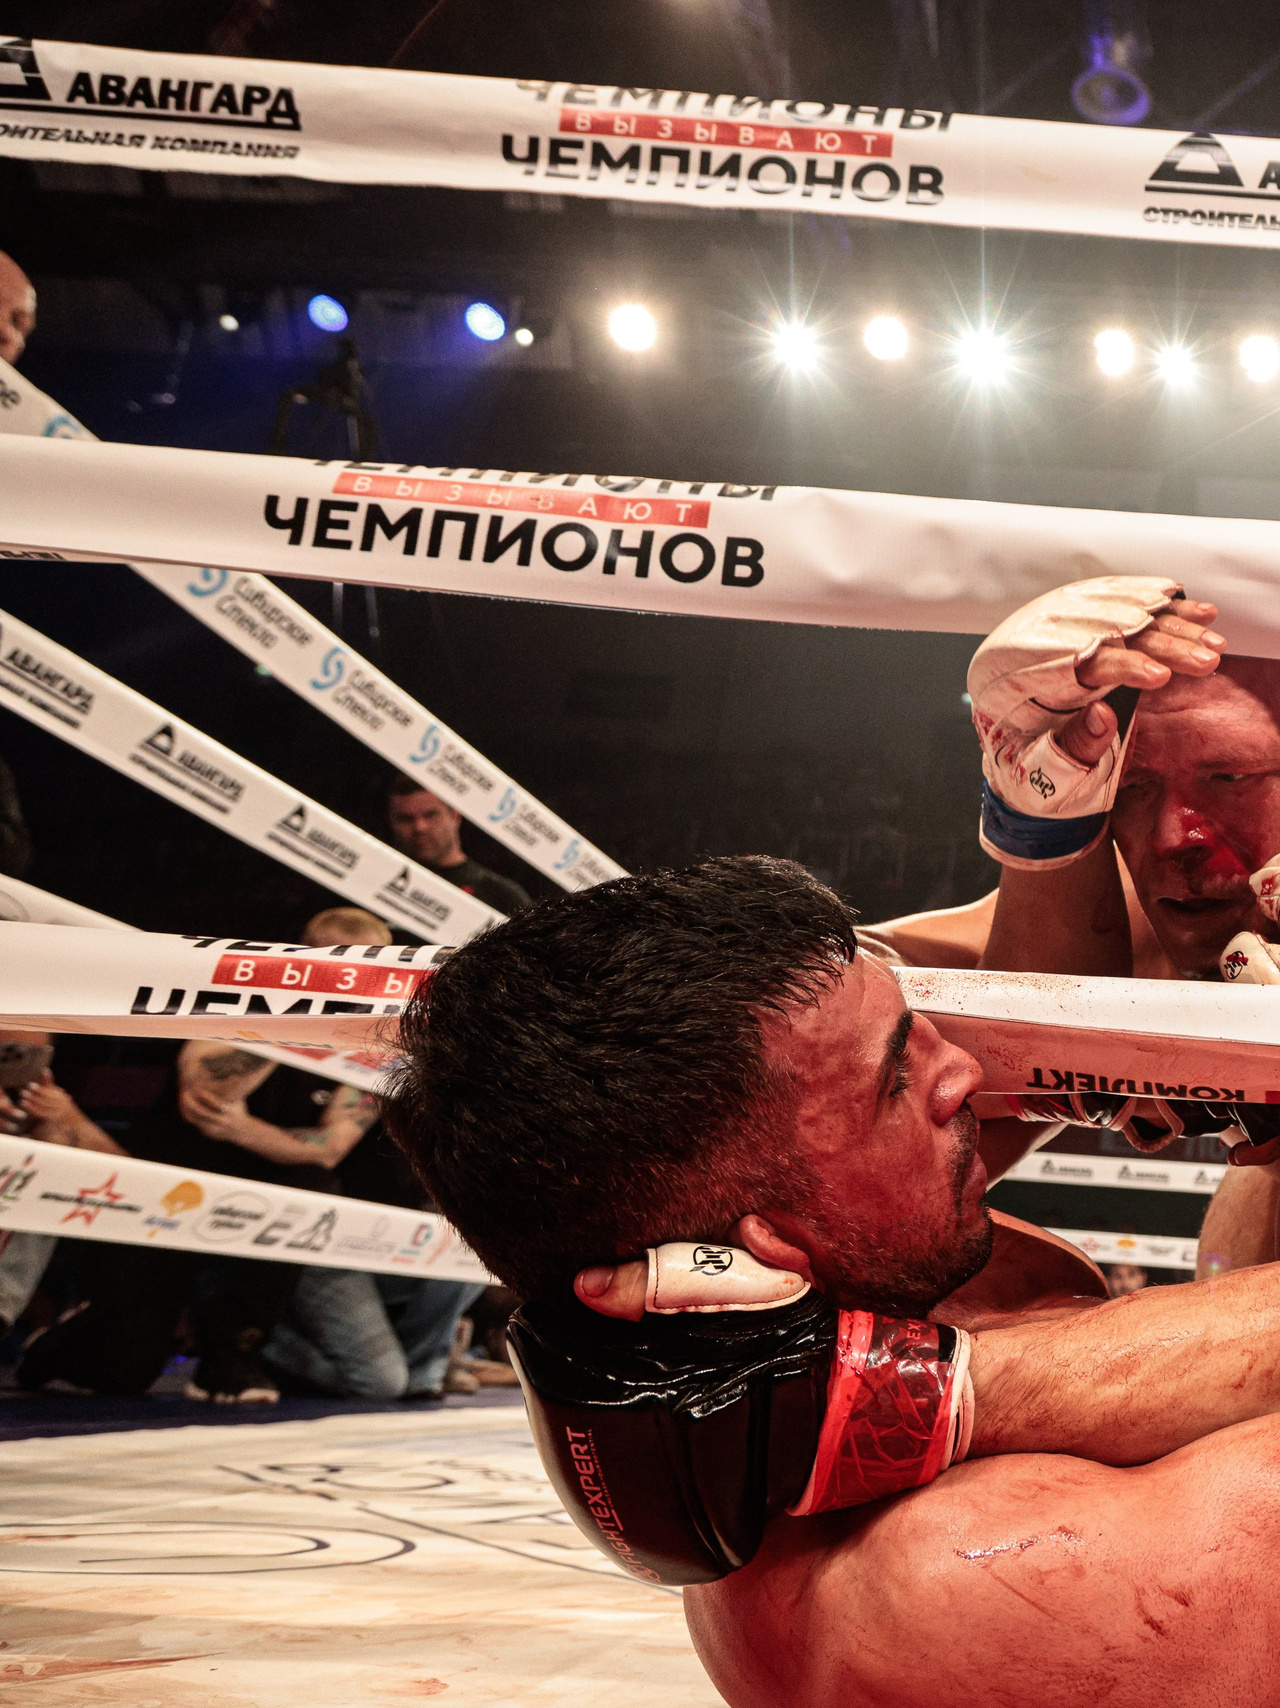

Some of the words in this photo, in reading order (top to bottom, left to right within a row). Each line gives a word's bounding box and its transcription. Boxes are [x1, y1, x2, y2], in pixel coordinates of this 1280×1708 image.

[66, 71, 302, 131] АВАНГАРД
[152, 135, 301, 159] КОМПАНИЯ
[574, 111, 878, 155] ВЫЗЫВАЮТ
[501, 134, 945, 206] ЧЕМПИОНОВ
[352, 474, 692, 524] ВЫЗЫВАЮТ
[262, 493, 766, 588] ЧЕМПИОНОВ
[233, 958, 415, 996] ВЫЗЫ
[1026, 1067, 1245, 1103] КОМПЛЕКТ
[565, 1426, 642, 1566] FIGHTEXPERT
